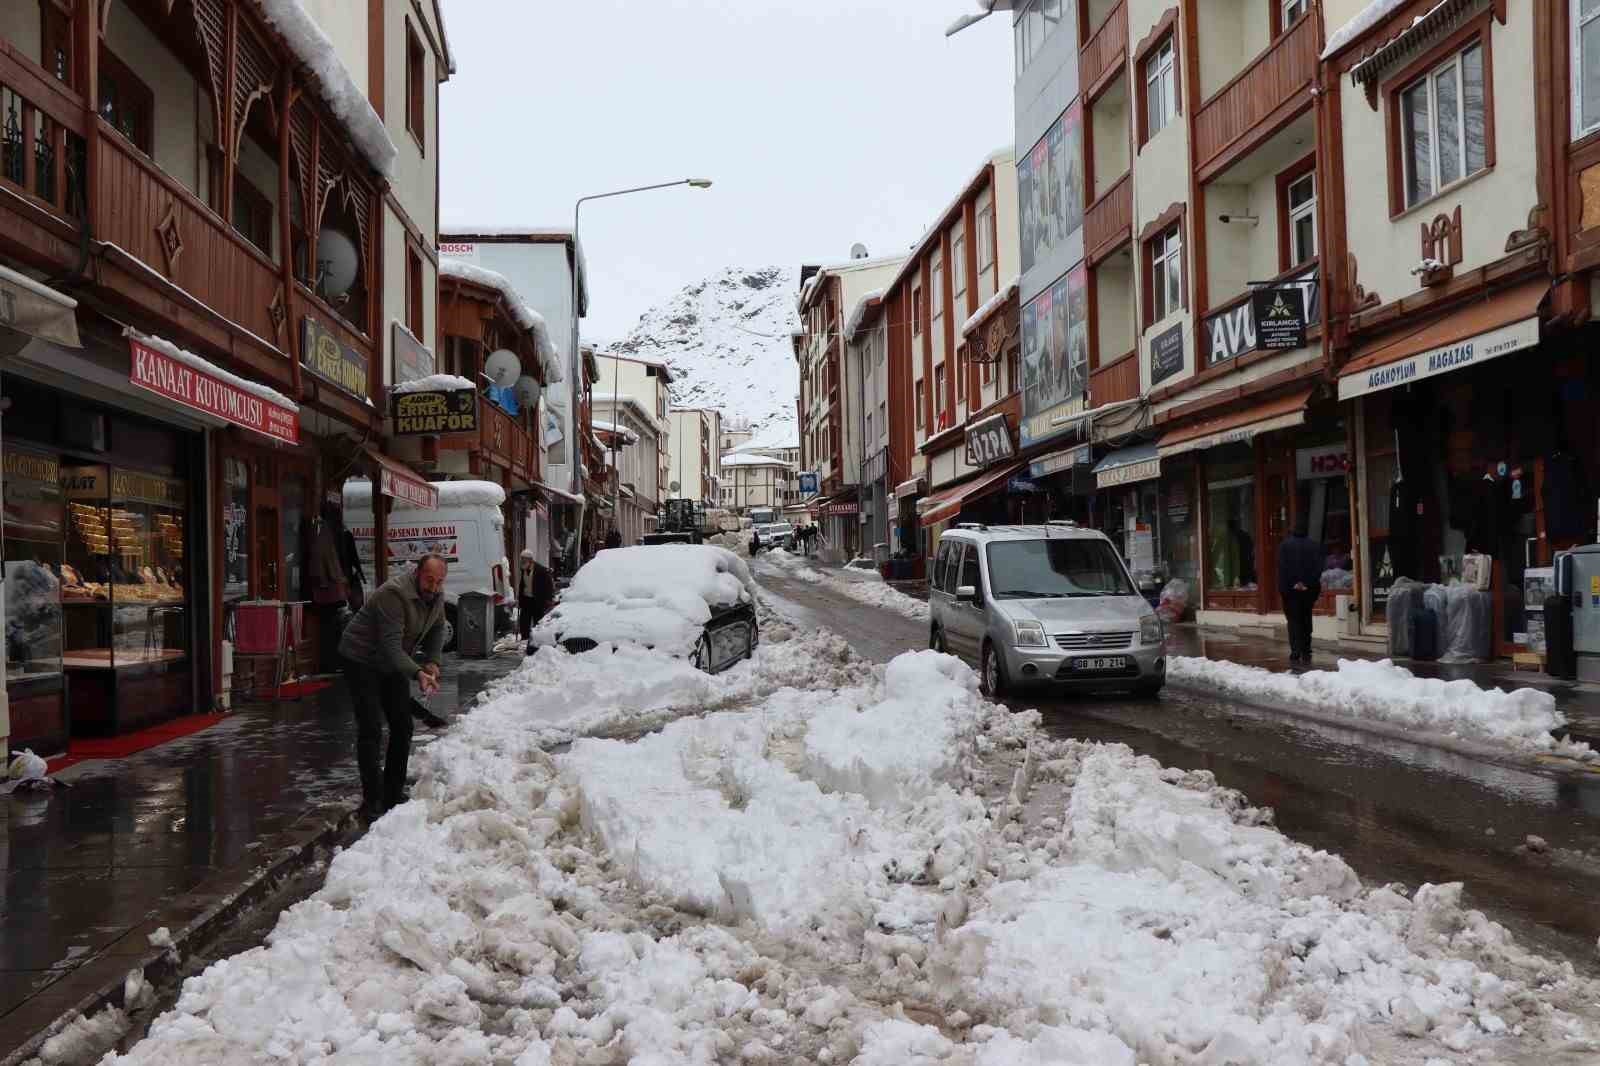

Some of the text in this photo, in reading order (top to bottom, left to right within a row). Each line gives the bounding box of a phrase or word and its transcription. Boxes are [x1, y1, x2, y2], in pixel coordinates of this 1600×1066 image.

[441, 244, 473, 252] BOSCH
[136, 347, 263, 425] KANAAT KUYUMCUSU
[398, 401, 448, 416] ERKEK
[398, 411, 475, 432] KUAFÖR
[970, 427, 1012, 463] ÖZPA
